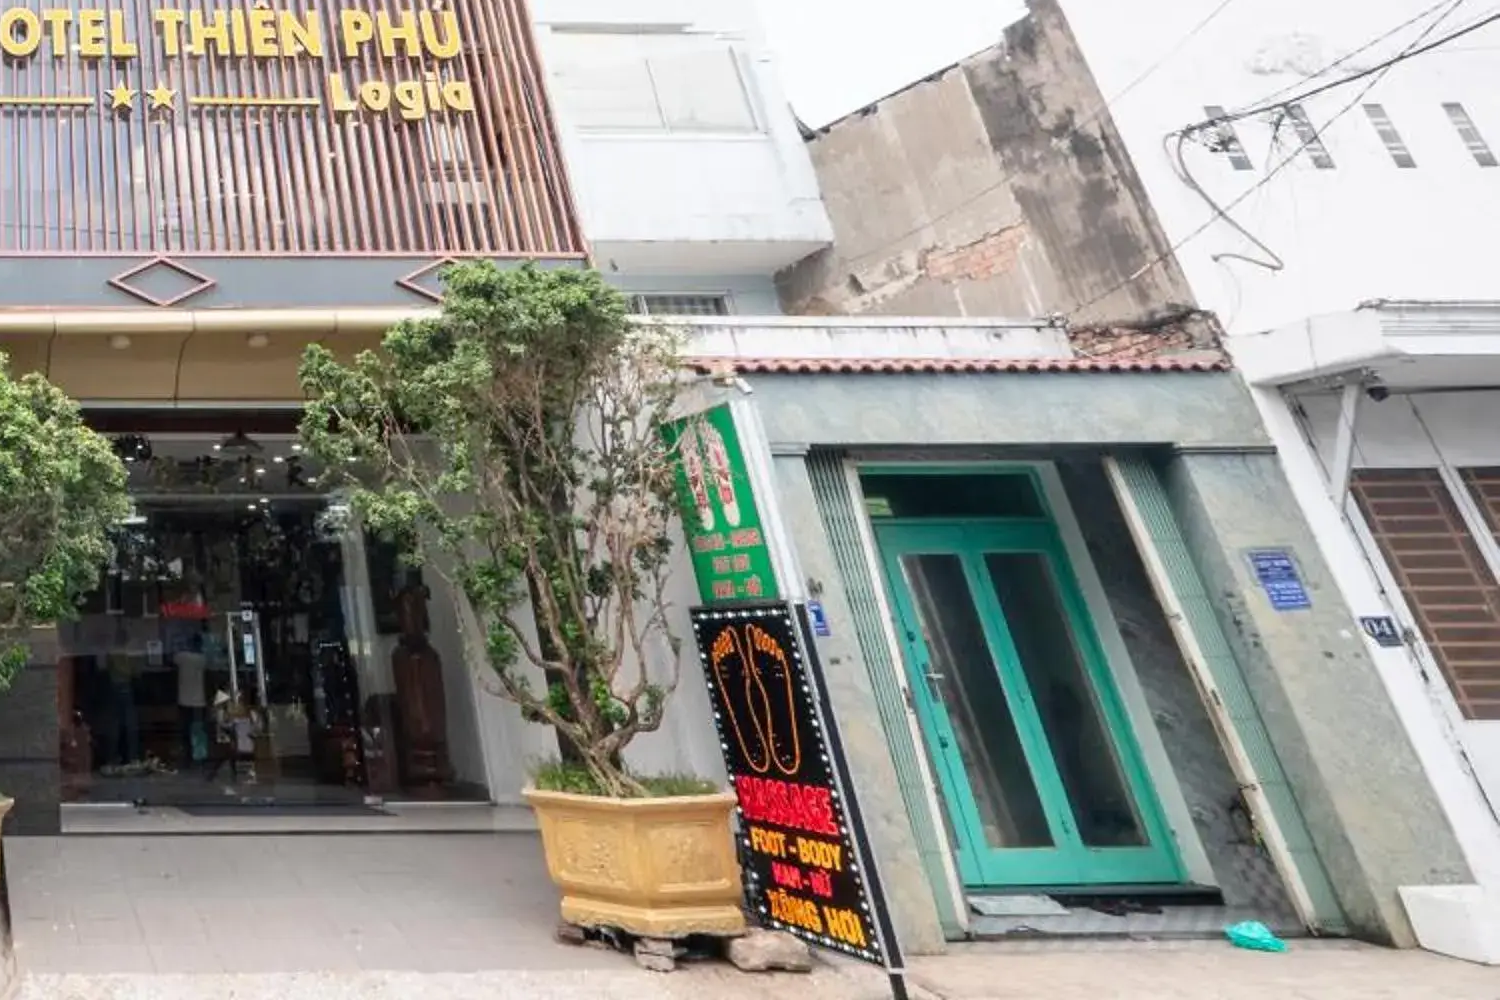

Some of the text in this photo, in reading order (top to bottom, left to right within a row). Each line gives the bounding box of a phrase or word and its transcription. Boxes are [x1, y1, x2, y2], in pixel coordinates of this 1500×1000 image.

[154, 0, 324, 59] THIÊN
[340, 0, 464, 60] PHÚ
[328, 72, 477, 121] Logia
[1364, 619, 1392, 636] 04
[735, 775, 839, 837] MASSAGE
[750, 825, 787, 859] FOOT
[797, 836, 842, 873] BODY
